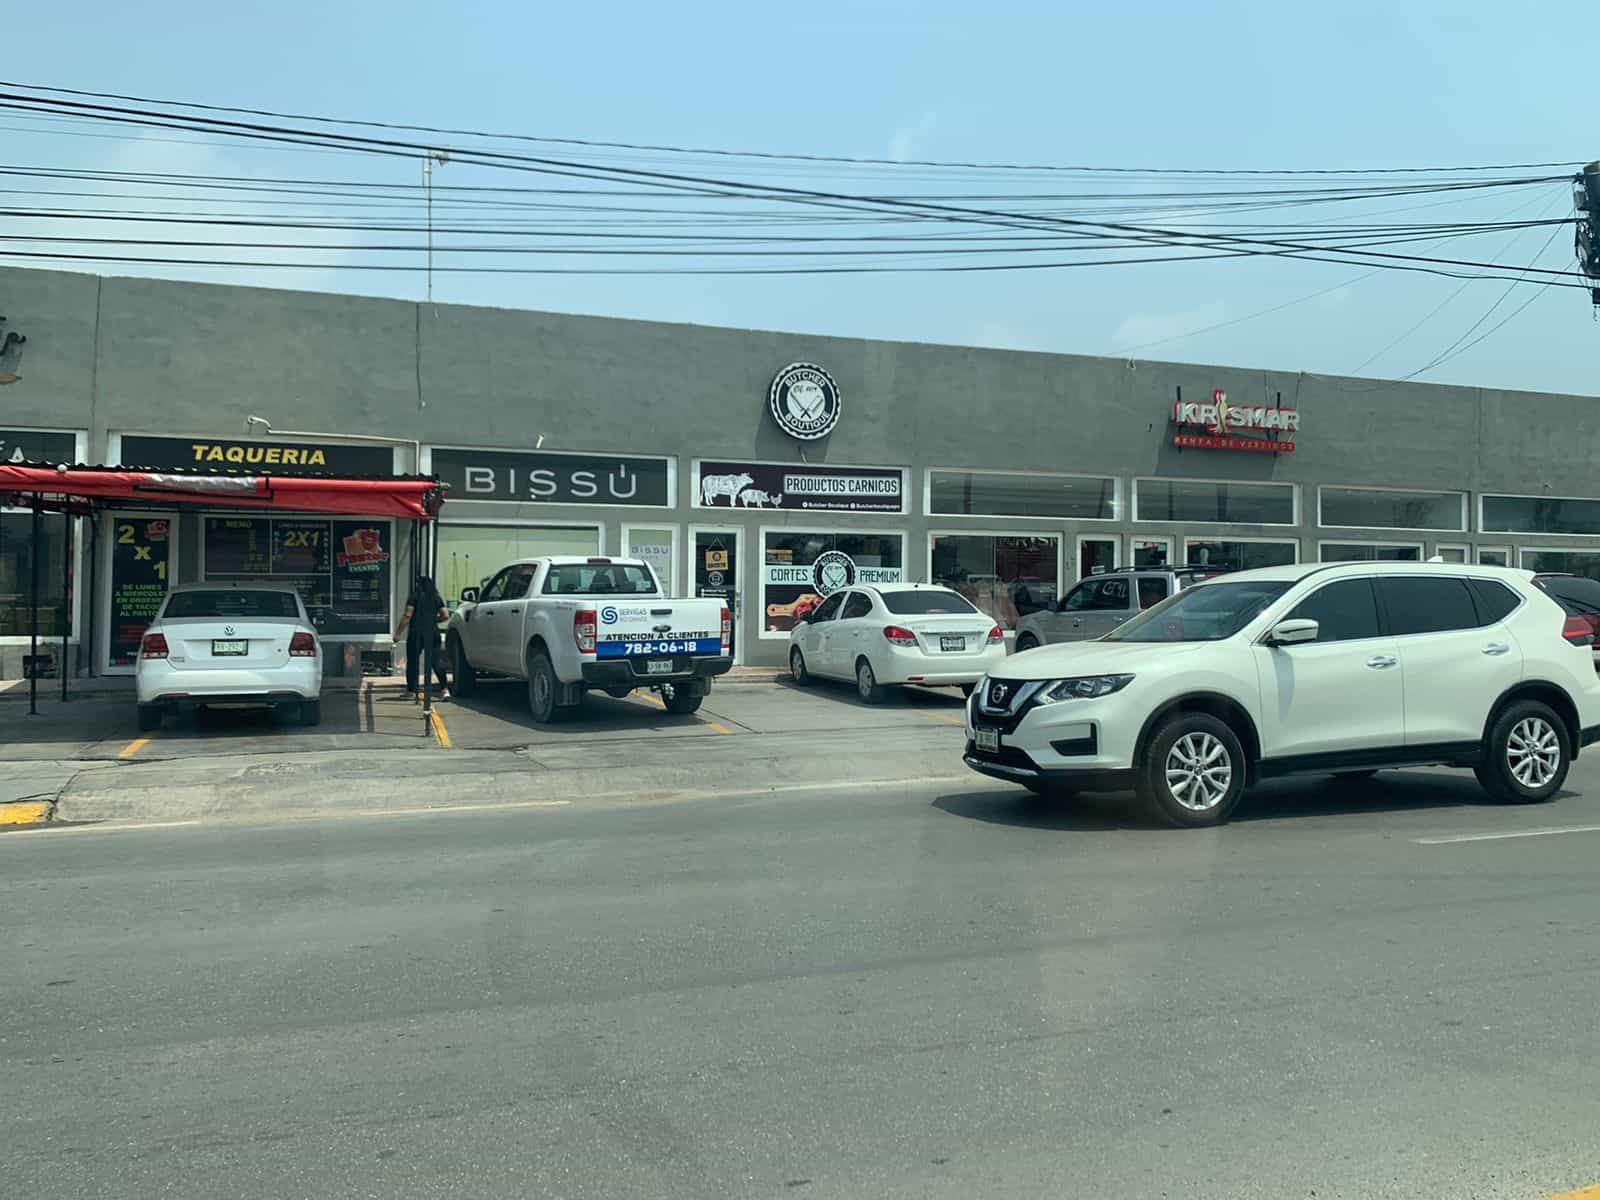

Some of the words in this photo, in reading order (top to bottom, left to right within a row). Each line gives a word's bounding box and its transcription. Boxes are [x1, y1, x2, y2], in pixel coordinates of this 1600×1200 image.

[785, 371, 826, 387] BUTCHER
[785, 410, 830, 430] BOUTIQUE
[192, 445, 326, 465] TAQUERIA
[786, 477, 846, 492] PRODUCTOS
[848, 479, 897, 493] CARNICOS
[118, 525, 135, 544] 2
[153, 561, 166, 579] 1
[770, 568, 809, 582] CORTES
[859, 569, 900, 583] PREMIUM
[606, 633, 654, 641] ATENCION
[667, 631, 709, 639] CLIENTES
[625, 641, 697, 654] 782-06-18
